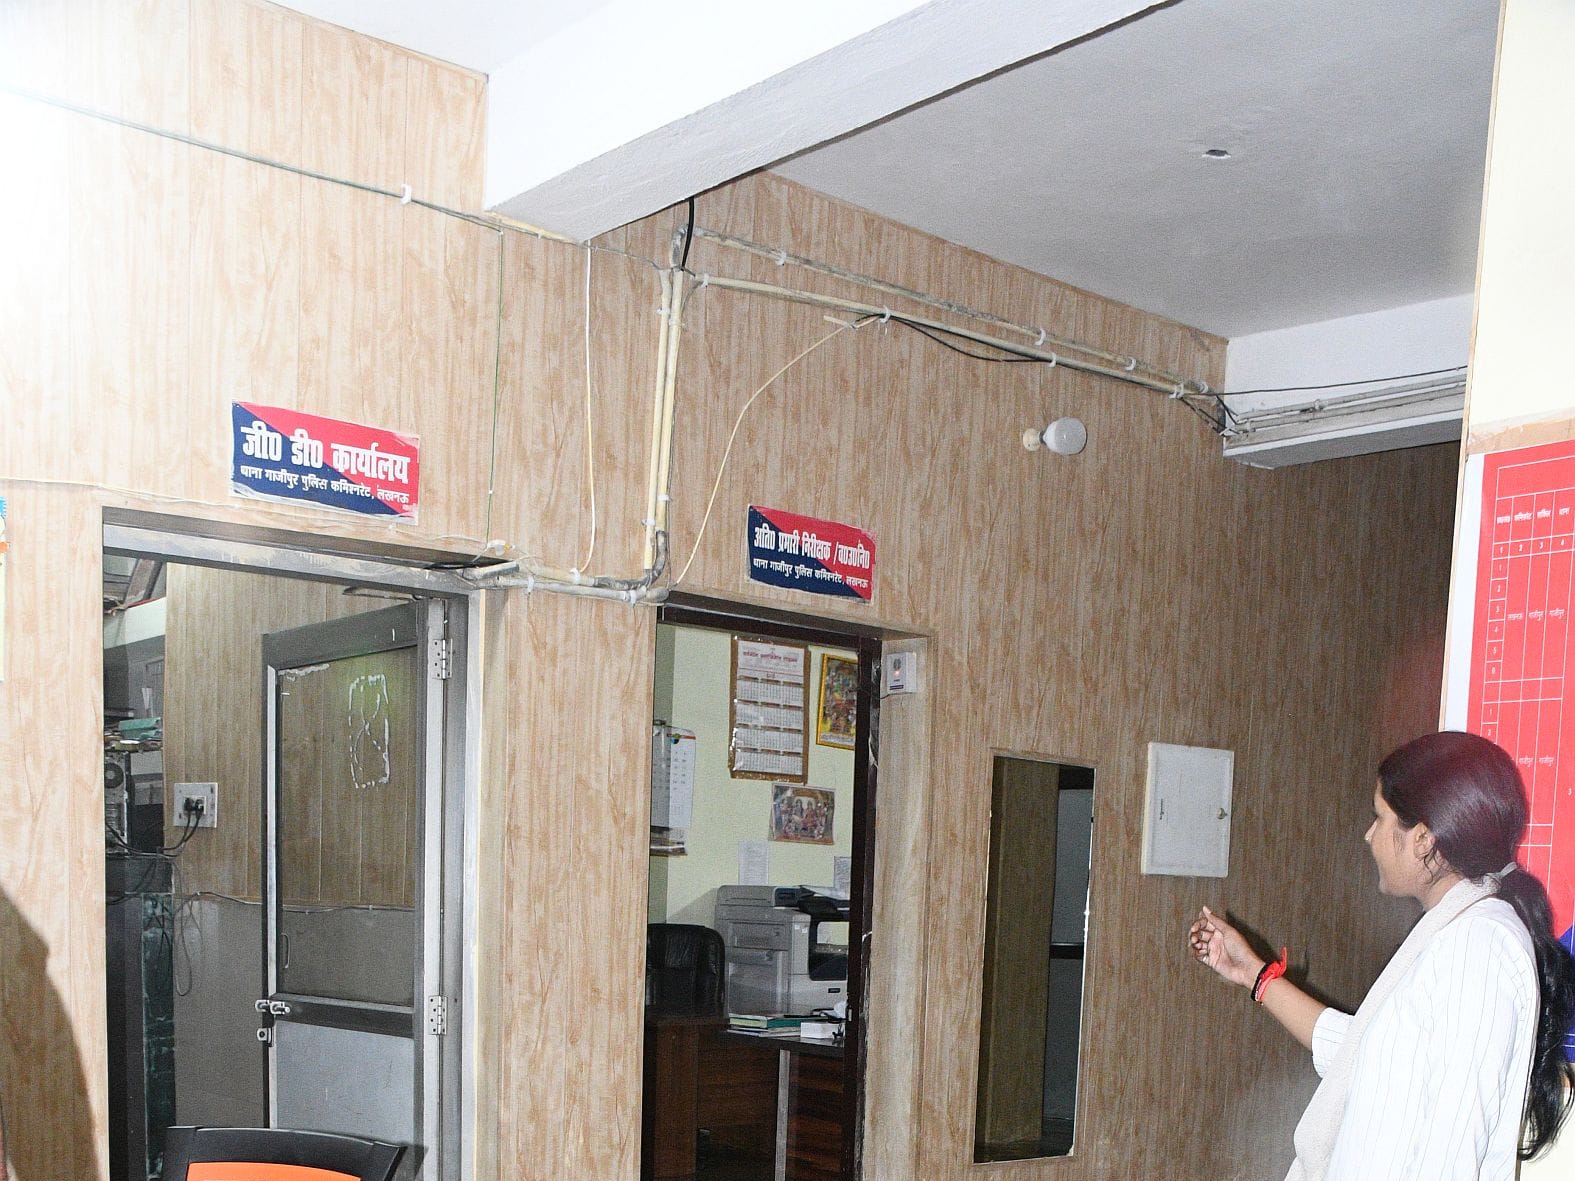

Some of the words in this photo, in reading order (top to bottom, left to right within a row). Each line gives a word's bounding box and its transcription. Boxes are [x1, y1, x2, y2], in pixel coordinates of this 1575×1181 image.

[330, 442, 411, 484] कार्यालय
[240, 464, 262, 480] थाना
[264, 468, 299, 490] गाजीपुर
[301, 473, 328, 491] पुलिस
[377, 488, 410, 504] लखनऊ
[778, 530, 800, 554] प्रभारी
[801, 532, 832, 561] निरीक्षक
[753, 558, 768, 569] थाना
[769, 561, 793, 577] गाजीपुर
[794, 564, 813, 580] पुलिस
[845, 575, 869, 588] लखनऊ
